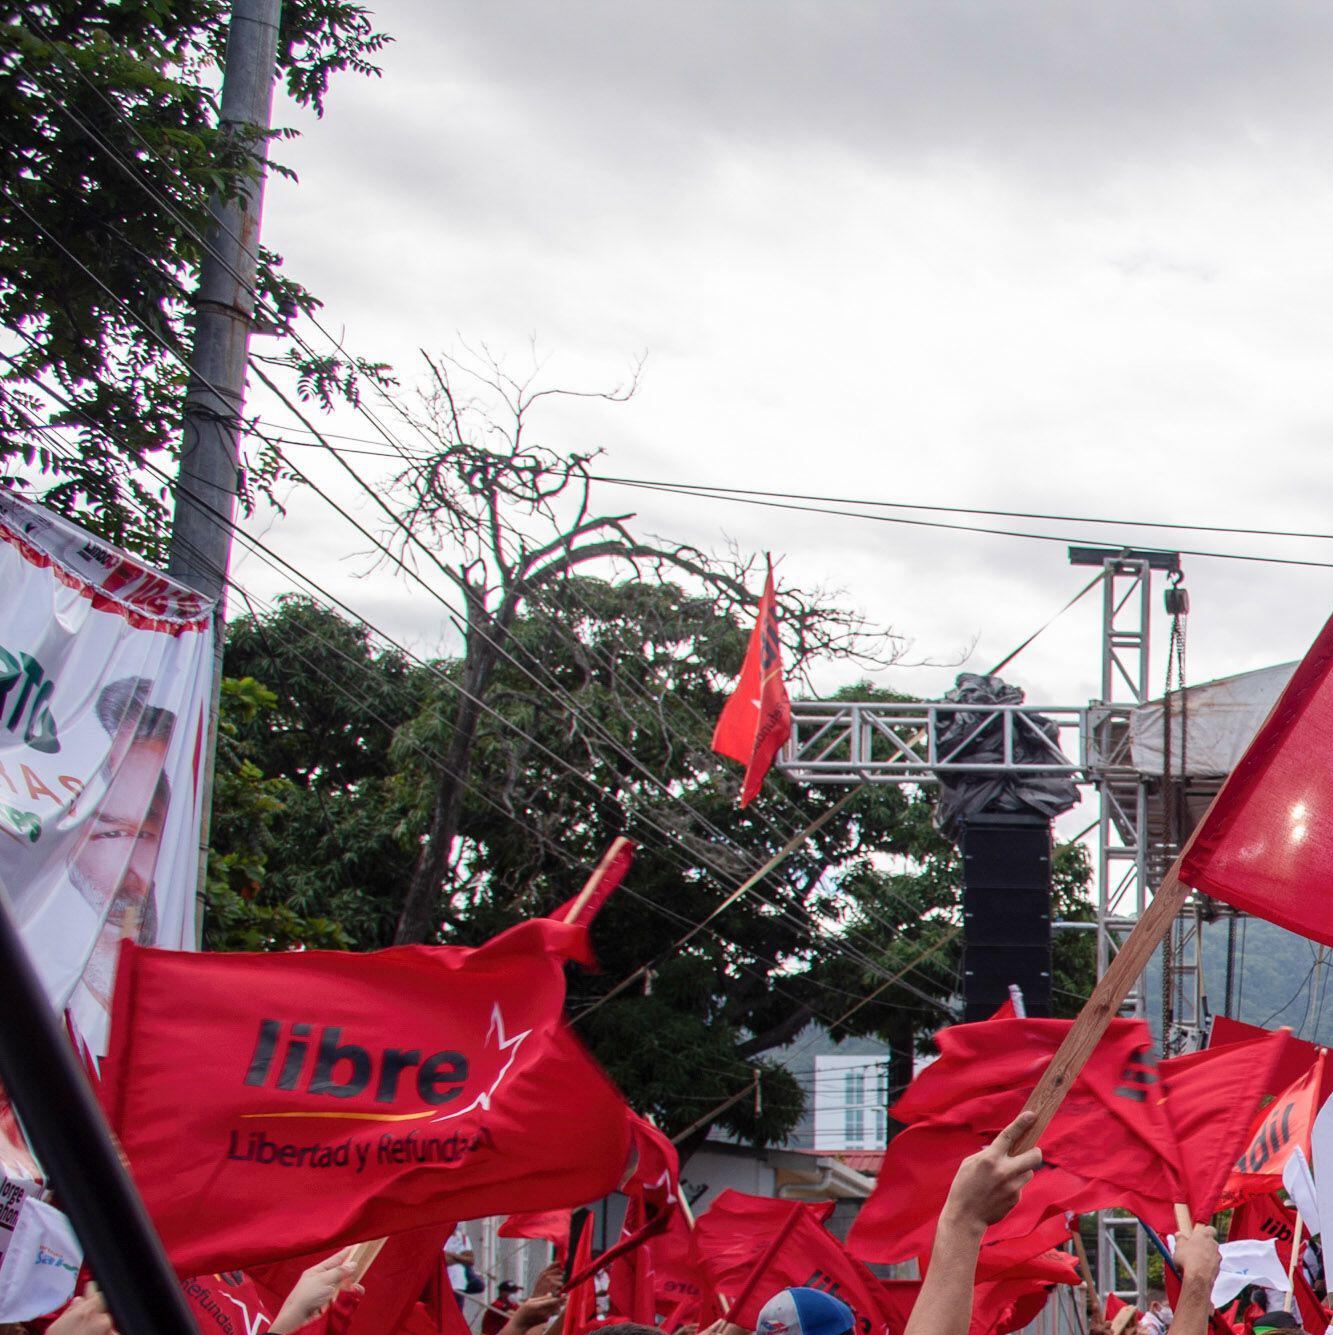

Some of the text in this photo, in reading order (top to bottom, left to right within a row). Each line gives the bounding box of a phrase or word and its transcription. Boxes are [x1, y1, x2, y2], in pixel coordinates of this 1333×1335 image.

[243, 1018, 469, 1106] libre
[227, 1129, 351, 1168] Libertad
[354, 1140, 372, 1173] y
